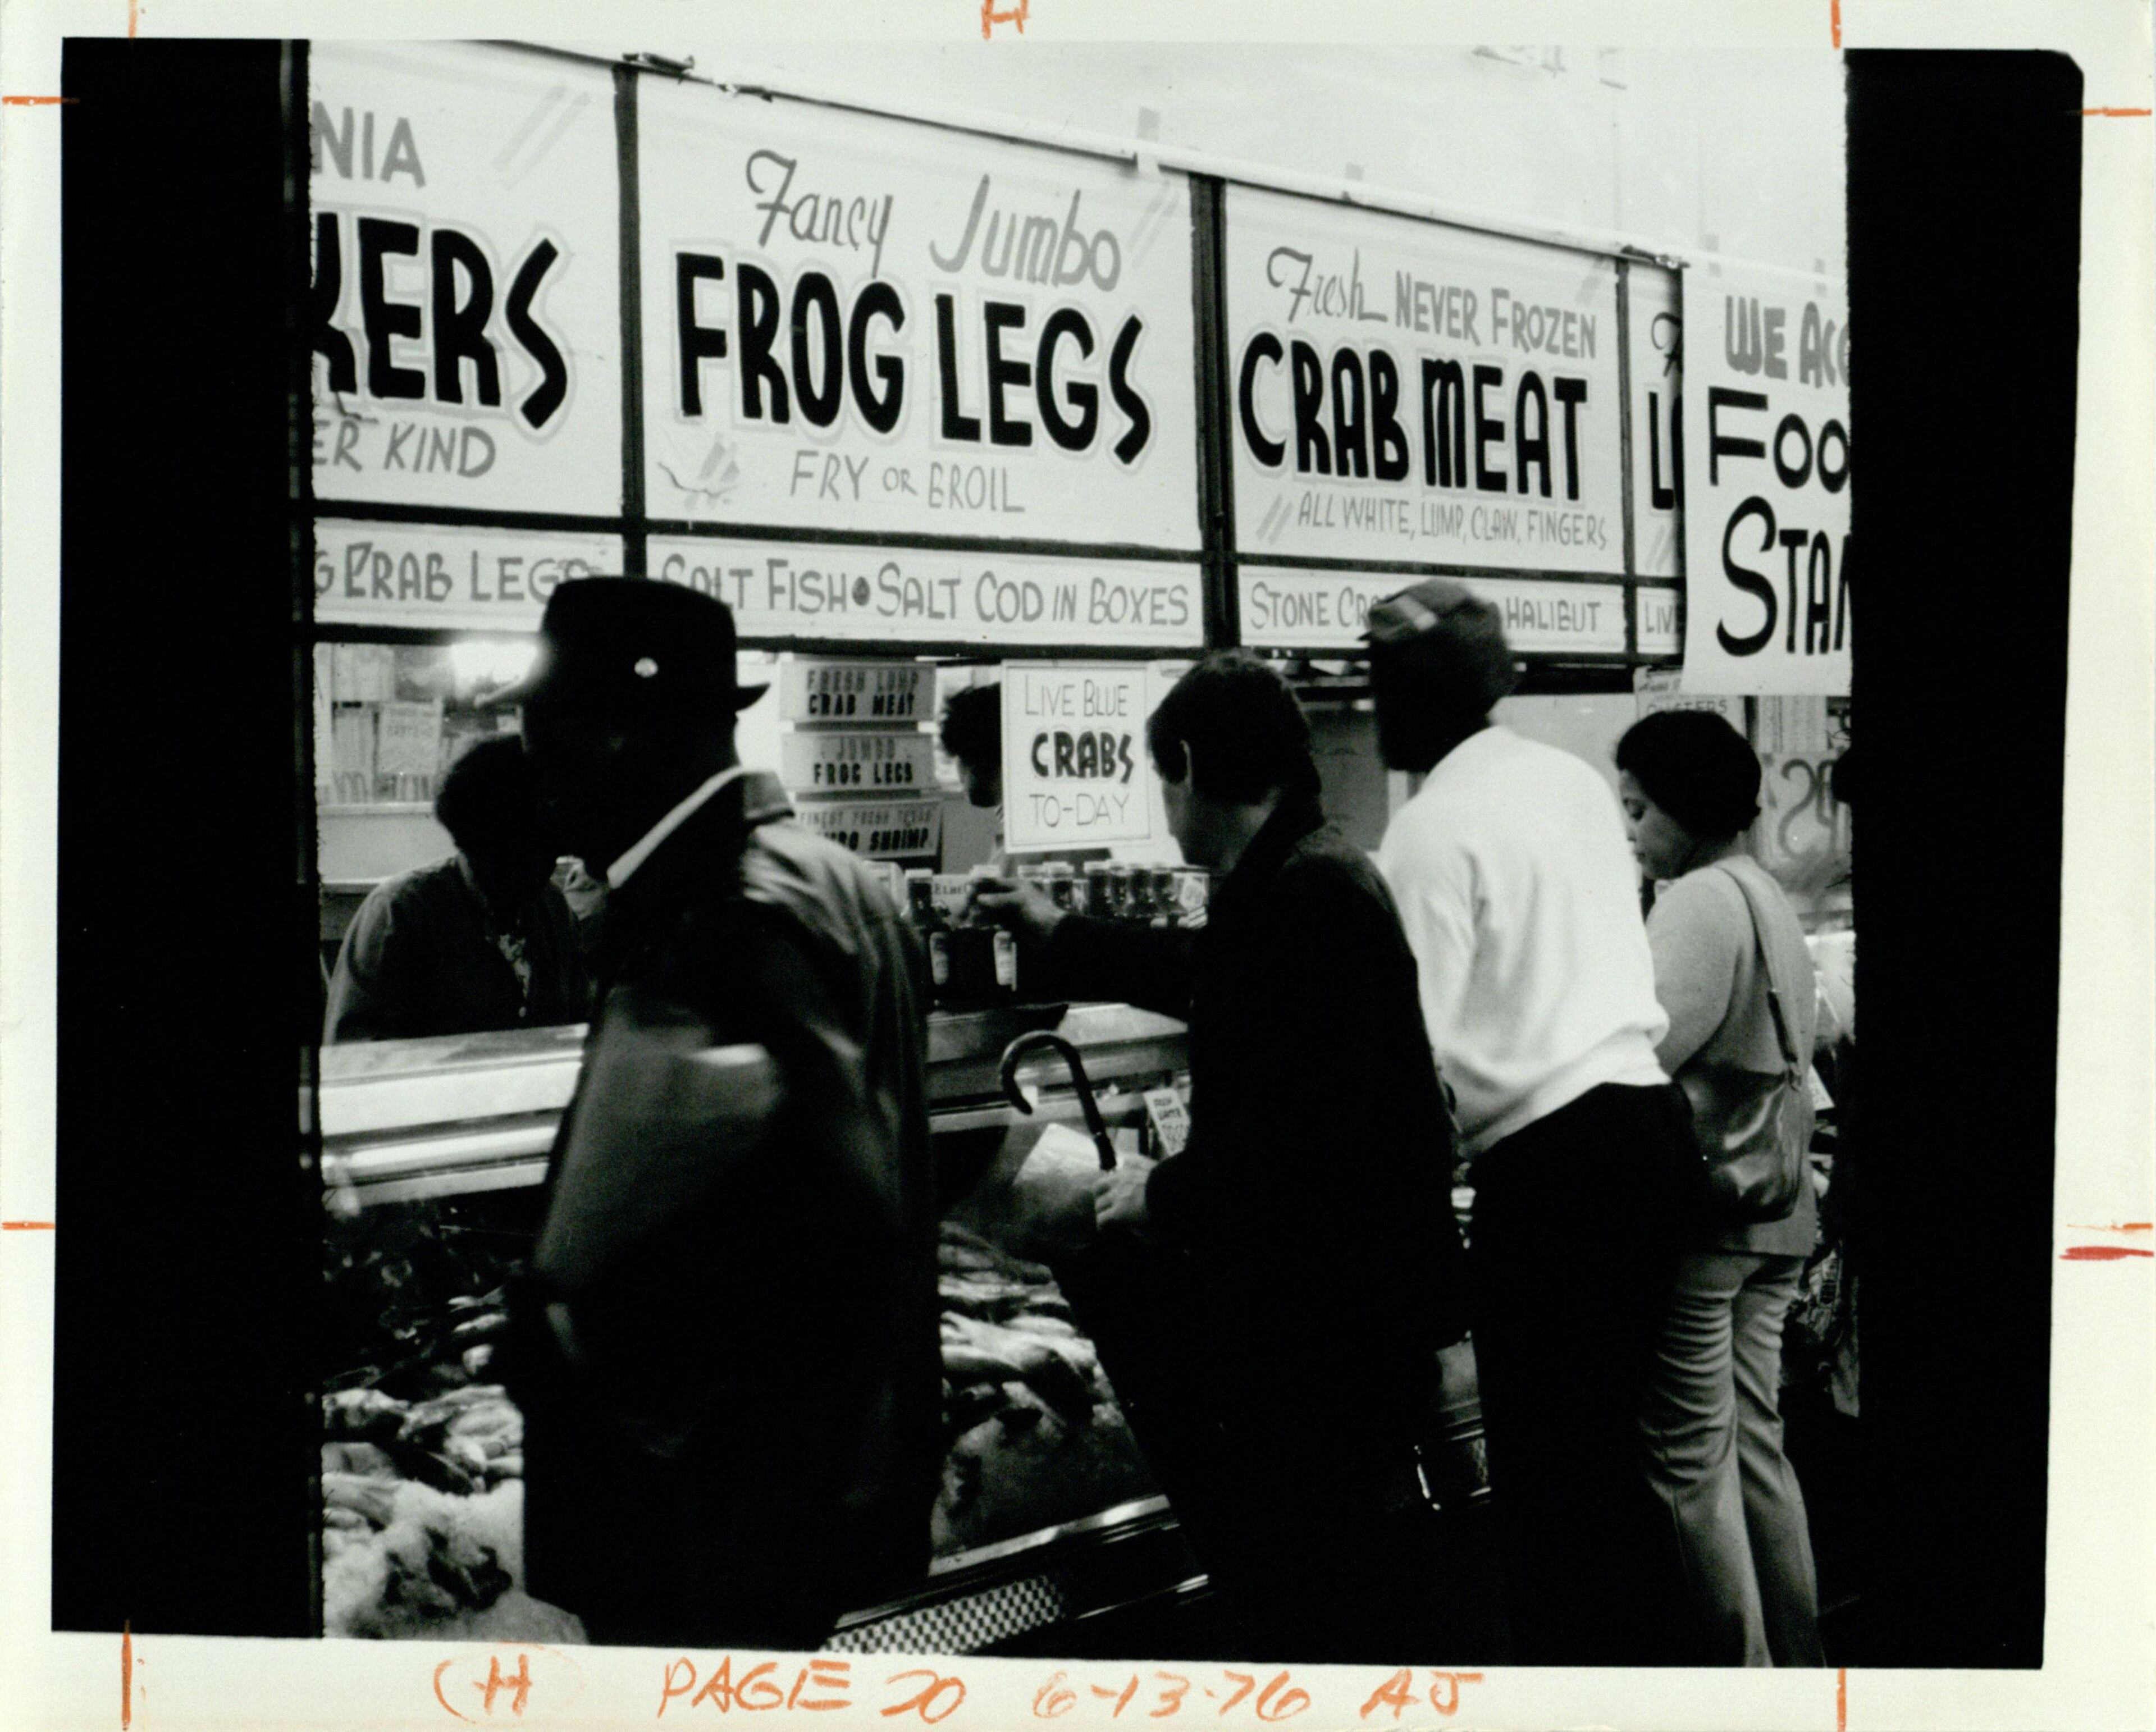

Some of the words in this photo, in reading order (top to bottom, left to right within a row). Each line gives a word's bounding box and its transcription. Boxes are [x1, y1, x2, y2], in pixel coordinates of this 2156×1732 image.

[746, 149, 893, 278] Fancy
[930, 174, 1122, 292] Jumbo
[1267, 247, 1387, 323] Fresh
[1396, 270, 1481, 347] NEVER
[1492, 287, 1596, 359] FROZEN
[676, 252, 906, 434] FROG
[935, 294, 1151, 465] LEGS
[1725, 295, 1787, 381] WE
[1239, 332, 1409, 482] CRAB
[1422, 358, 1587, 501] MEAT
[384, 422, 496, 478] KIND
[790, 450, 870, 500] FRY
[929, 462, 1026, 513] BROIL
[1299, 491, 1335, 528] ALL
[1527, 509, 1606, 549] FINGERS
[766, 559, 847, 613] FISH
[876, 562, 961, 620] SALT
[976, 570, 1043, 623] COD
[1052, 585, 1076, 623] IN
[1088, 577, 1189, 627] BOXES
[1250, 581, 1330, 629] STONE
[1506, 596, 1601, 633] HALIBUT
[808, 693, 856, 715] CRAB
[872, 692, 915, 715] MEAT
[1025, 674, 1075, 716] LIVE
[1084, 678, 1129, 718] BLUE
[814, 762, 861, 784] FROG
[874, 762, 913, 784] LEGS
[1031, 730, 1134, 784] CRABS
[1029, 793, 1130, 828] TO-DAY
[657, 1655, 852, 1718] PAGE
